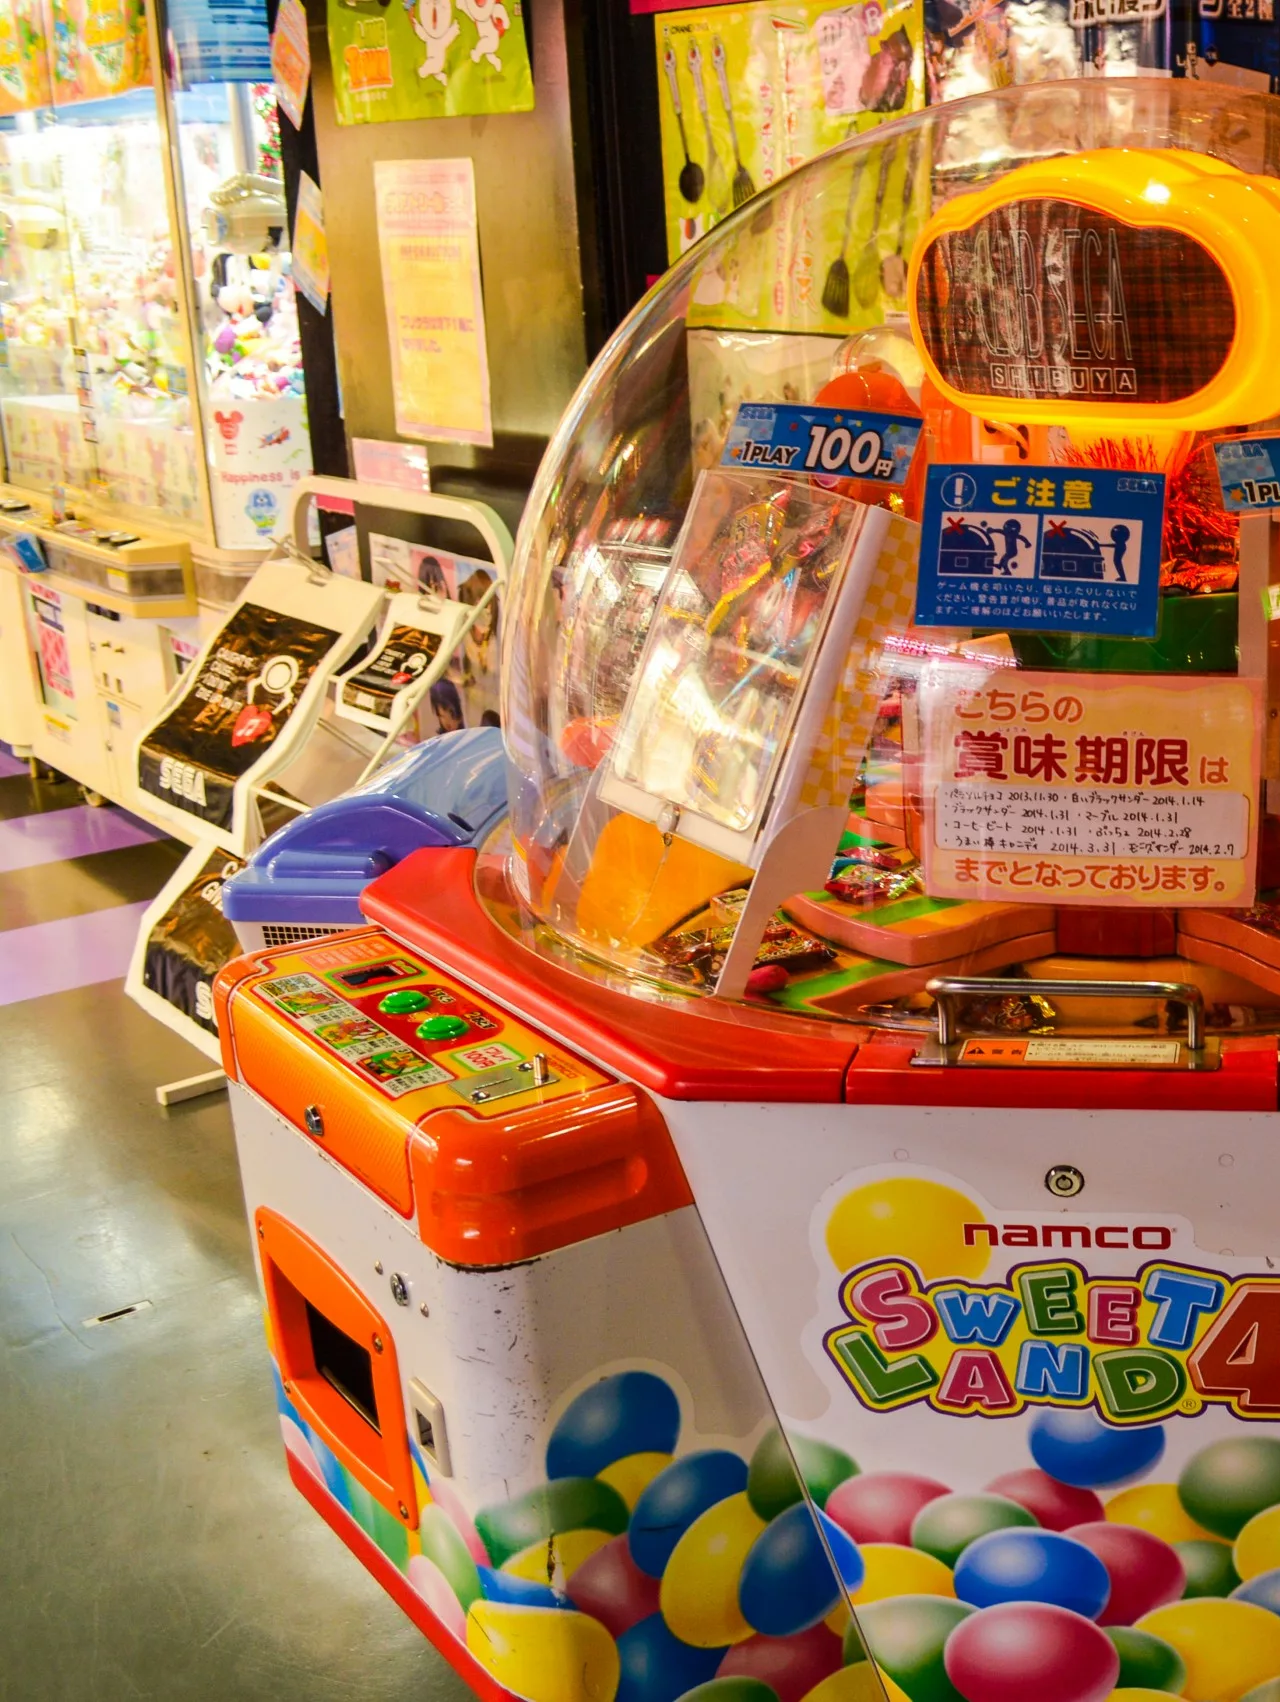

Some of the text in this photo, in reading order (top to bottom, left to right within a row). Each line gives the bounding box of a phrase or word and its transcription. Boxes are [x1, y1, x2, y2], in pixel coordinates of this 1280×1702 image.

[992, 365, 1136, 392] SHIBUYA
[741, 424, 895, 478] 1PLAY 100円
[991, 476, 1095, 510] ご注意
[1116, 477, 1158, 494] SEGA
[954, 688, 1083, 723] こちらの
[159, 756, 208, 807] SEGA
[954, 857, 1226, 892] までとなっております。
[963, 1221, 1172, 1250] namco
[850, 1267, 1224, 1353] SWEET
[835, 1331, 1187, 1418] LAND
